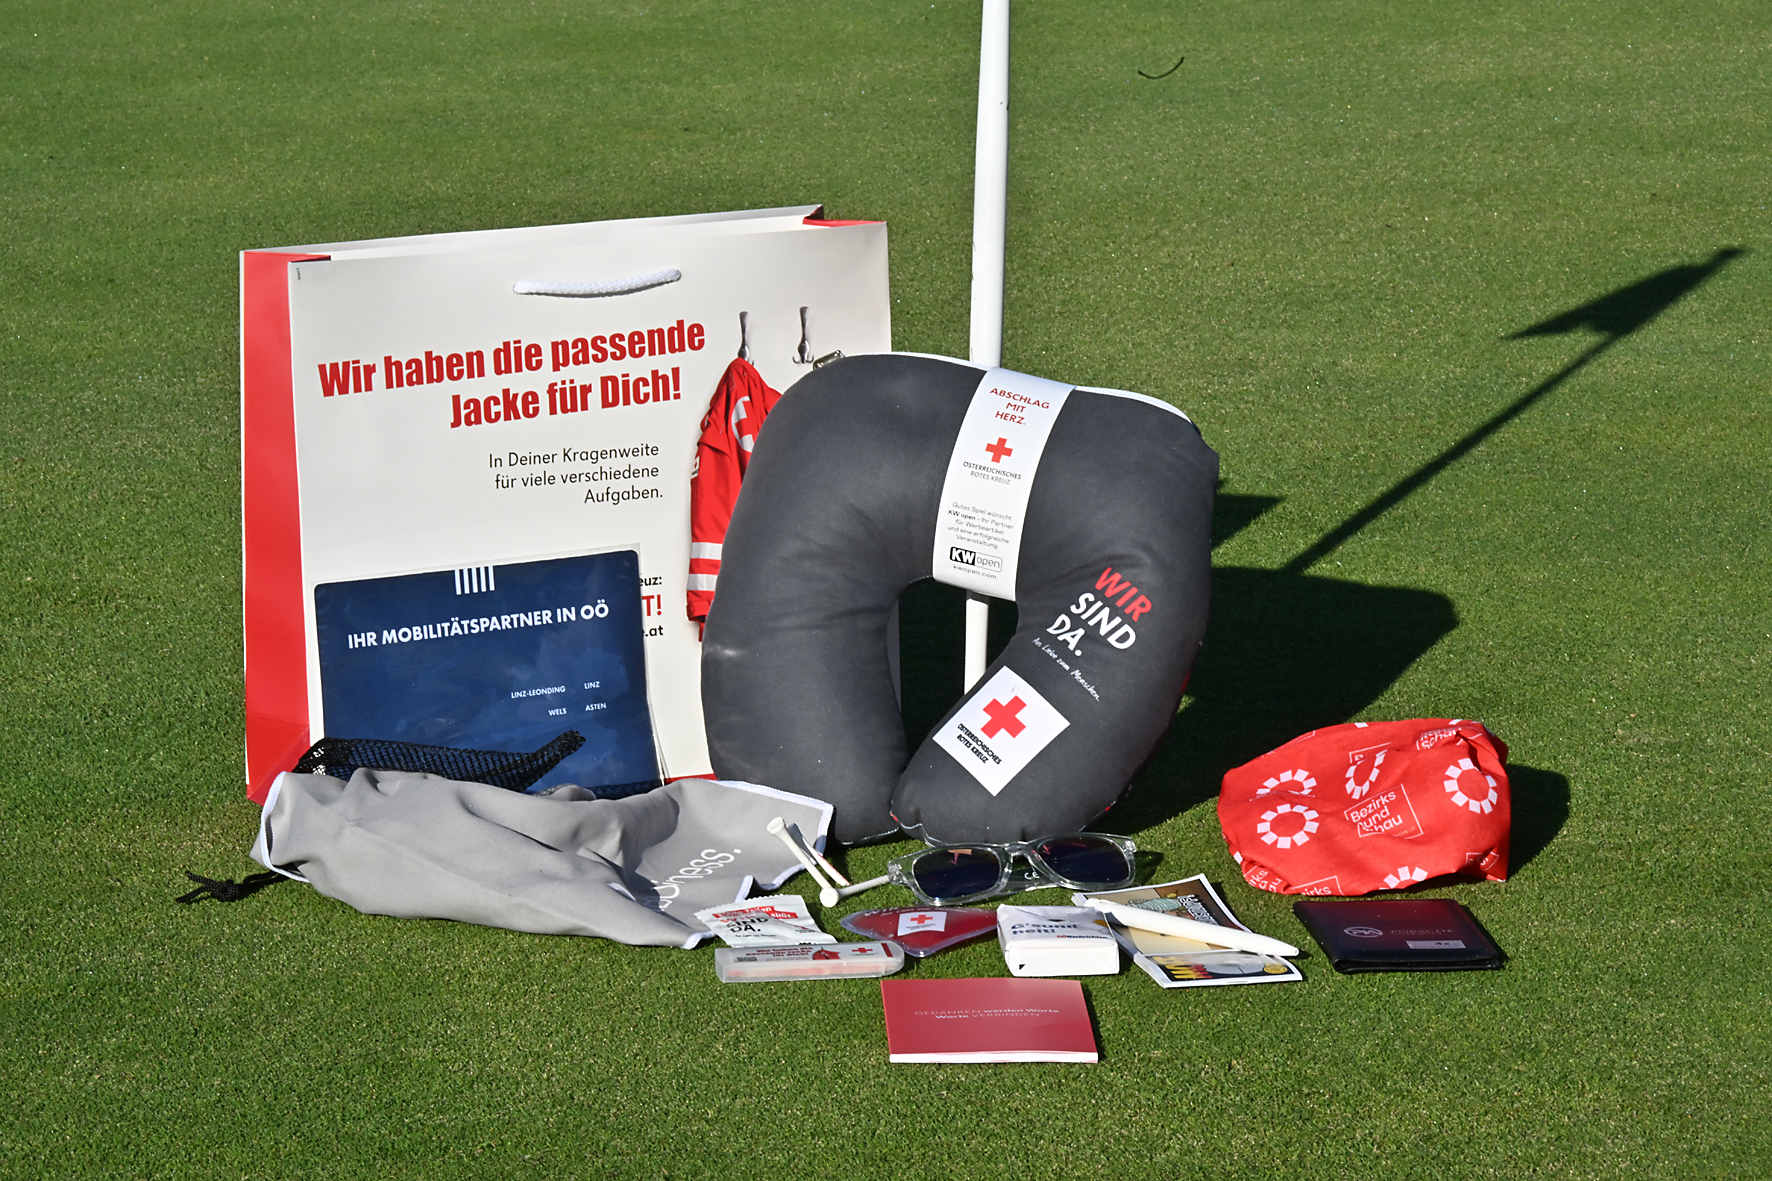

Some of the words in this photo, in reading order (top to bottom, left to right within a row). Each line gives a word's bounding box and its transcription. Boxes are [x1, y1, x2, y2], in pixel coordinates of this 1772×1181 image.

[318, 359, 377, 397] Wir
[384, 350, 486, 390] haben
[493, 339, 543, 376] die
[551, 319, 705, 372] passende
[450, 388, 540, 428] Jacke
[547, 378, 593, 416] für
[600, 366, 682, 409] Dich!
[989, 387, 1050, 409] ABSCHLAG
[1005, 402, 1027, 413] MIT
[489, 453, 503, 468] In
[508, 451, 558, 467] Deiner
[562, 443, 659, 465] Kragenweite
[495, 474, 517, 489] für
[521, 470, 556, 487] viele
[560, 464, 659, 484] verschiedene
[962, 460, 1022, 480] ÖSTERREICHISCHES
[970, 470, 990, 480] ROTES
[990, 475, 1011, 485] KREUZ
[584, 485, 663, 505] Aufgaben.
[948, 509, 960, 517] KW
[960, 513, 976, 521] open
[990, 520, 1014, 529] Partner
[952, 501, 971, 511] Gutes
[971, 506, 986, 515] Spiel
[987, 510, 1012, 521] wünscht
[965, 521, 1005, 535] Werbeartikel
[973, 530, 1010, 544] erfolgreiche
[951, 547, 976, 565] KW
[976, 556, 1001, 569] open
[953, 564, 997, 580] kwopen.com
[1094, 566, 1152, 623] WIR
[347, 631, 378, 649] IHR
[381, 609, 553, 645] MOBILITÄTSPARTNER
[556, 606, 577, 623] IN
[580, 598, 609, 620] OÖ
[1069, 592, 1137, 650] SIND
[1046, 613, 1083, 657] DA.
[511, 685, 566, 699] LINZ-LEONDING
[584, 681, 600, 690] LINZ
[548, 707, 567, 716] WELS
[585, 702, 607, 712] ASTEN
[1350, 791, 1397, 823] Bezirks
[1362, 814, 1403, 832] hau
